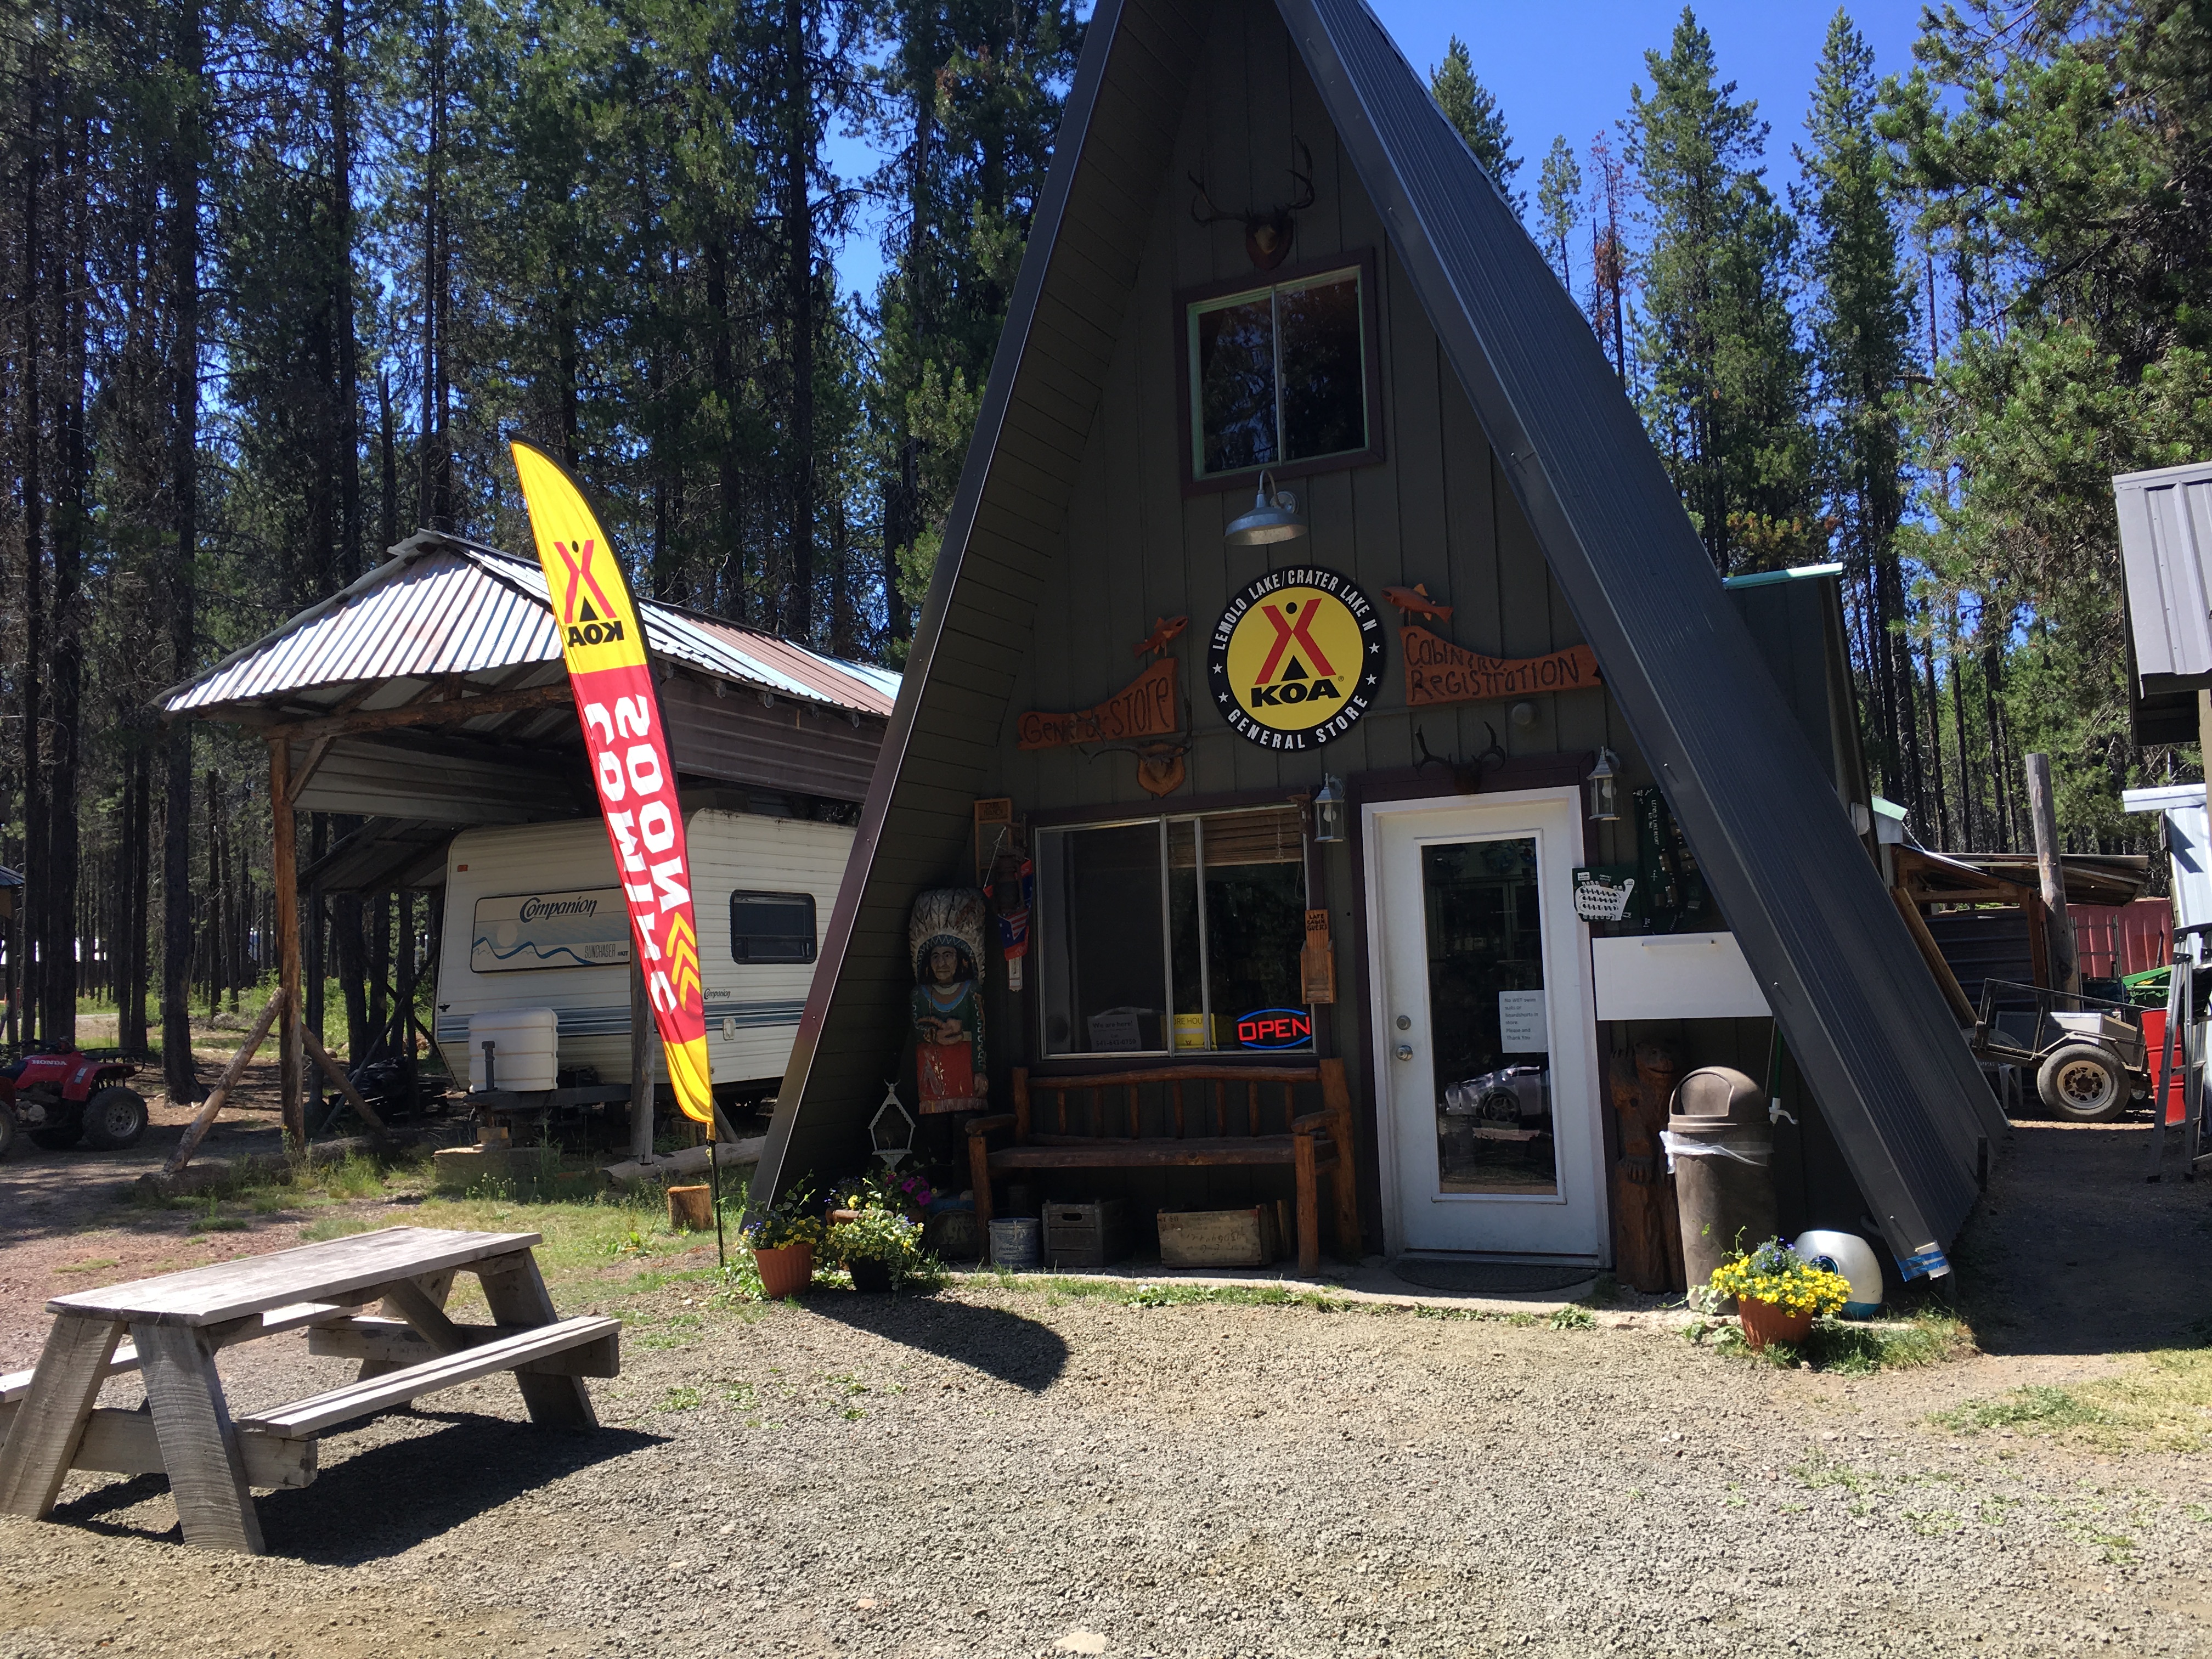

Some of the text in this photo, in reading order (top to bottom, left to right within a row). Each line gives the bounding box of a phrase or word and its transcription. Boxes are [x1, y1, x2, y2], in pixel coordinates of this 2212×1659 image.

[1212, 569, 1378, 650] LEMOLO LAKE/CRATER LAKE N
[1477, 657, 1504, 672] RV
[1251, 679, 1341, 708] KOA
[1228, 695, 1368, 749] GENERAL STORE
[520, 896, 597, 923] Companion
[584, 944, 616, 958] SUNCHASER
[704, 988, 731, 1000] Companion
[1238, 1016, 1311, 1041] OPEN
